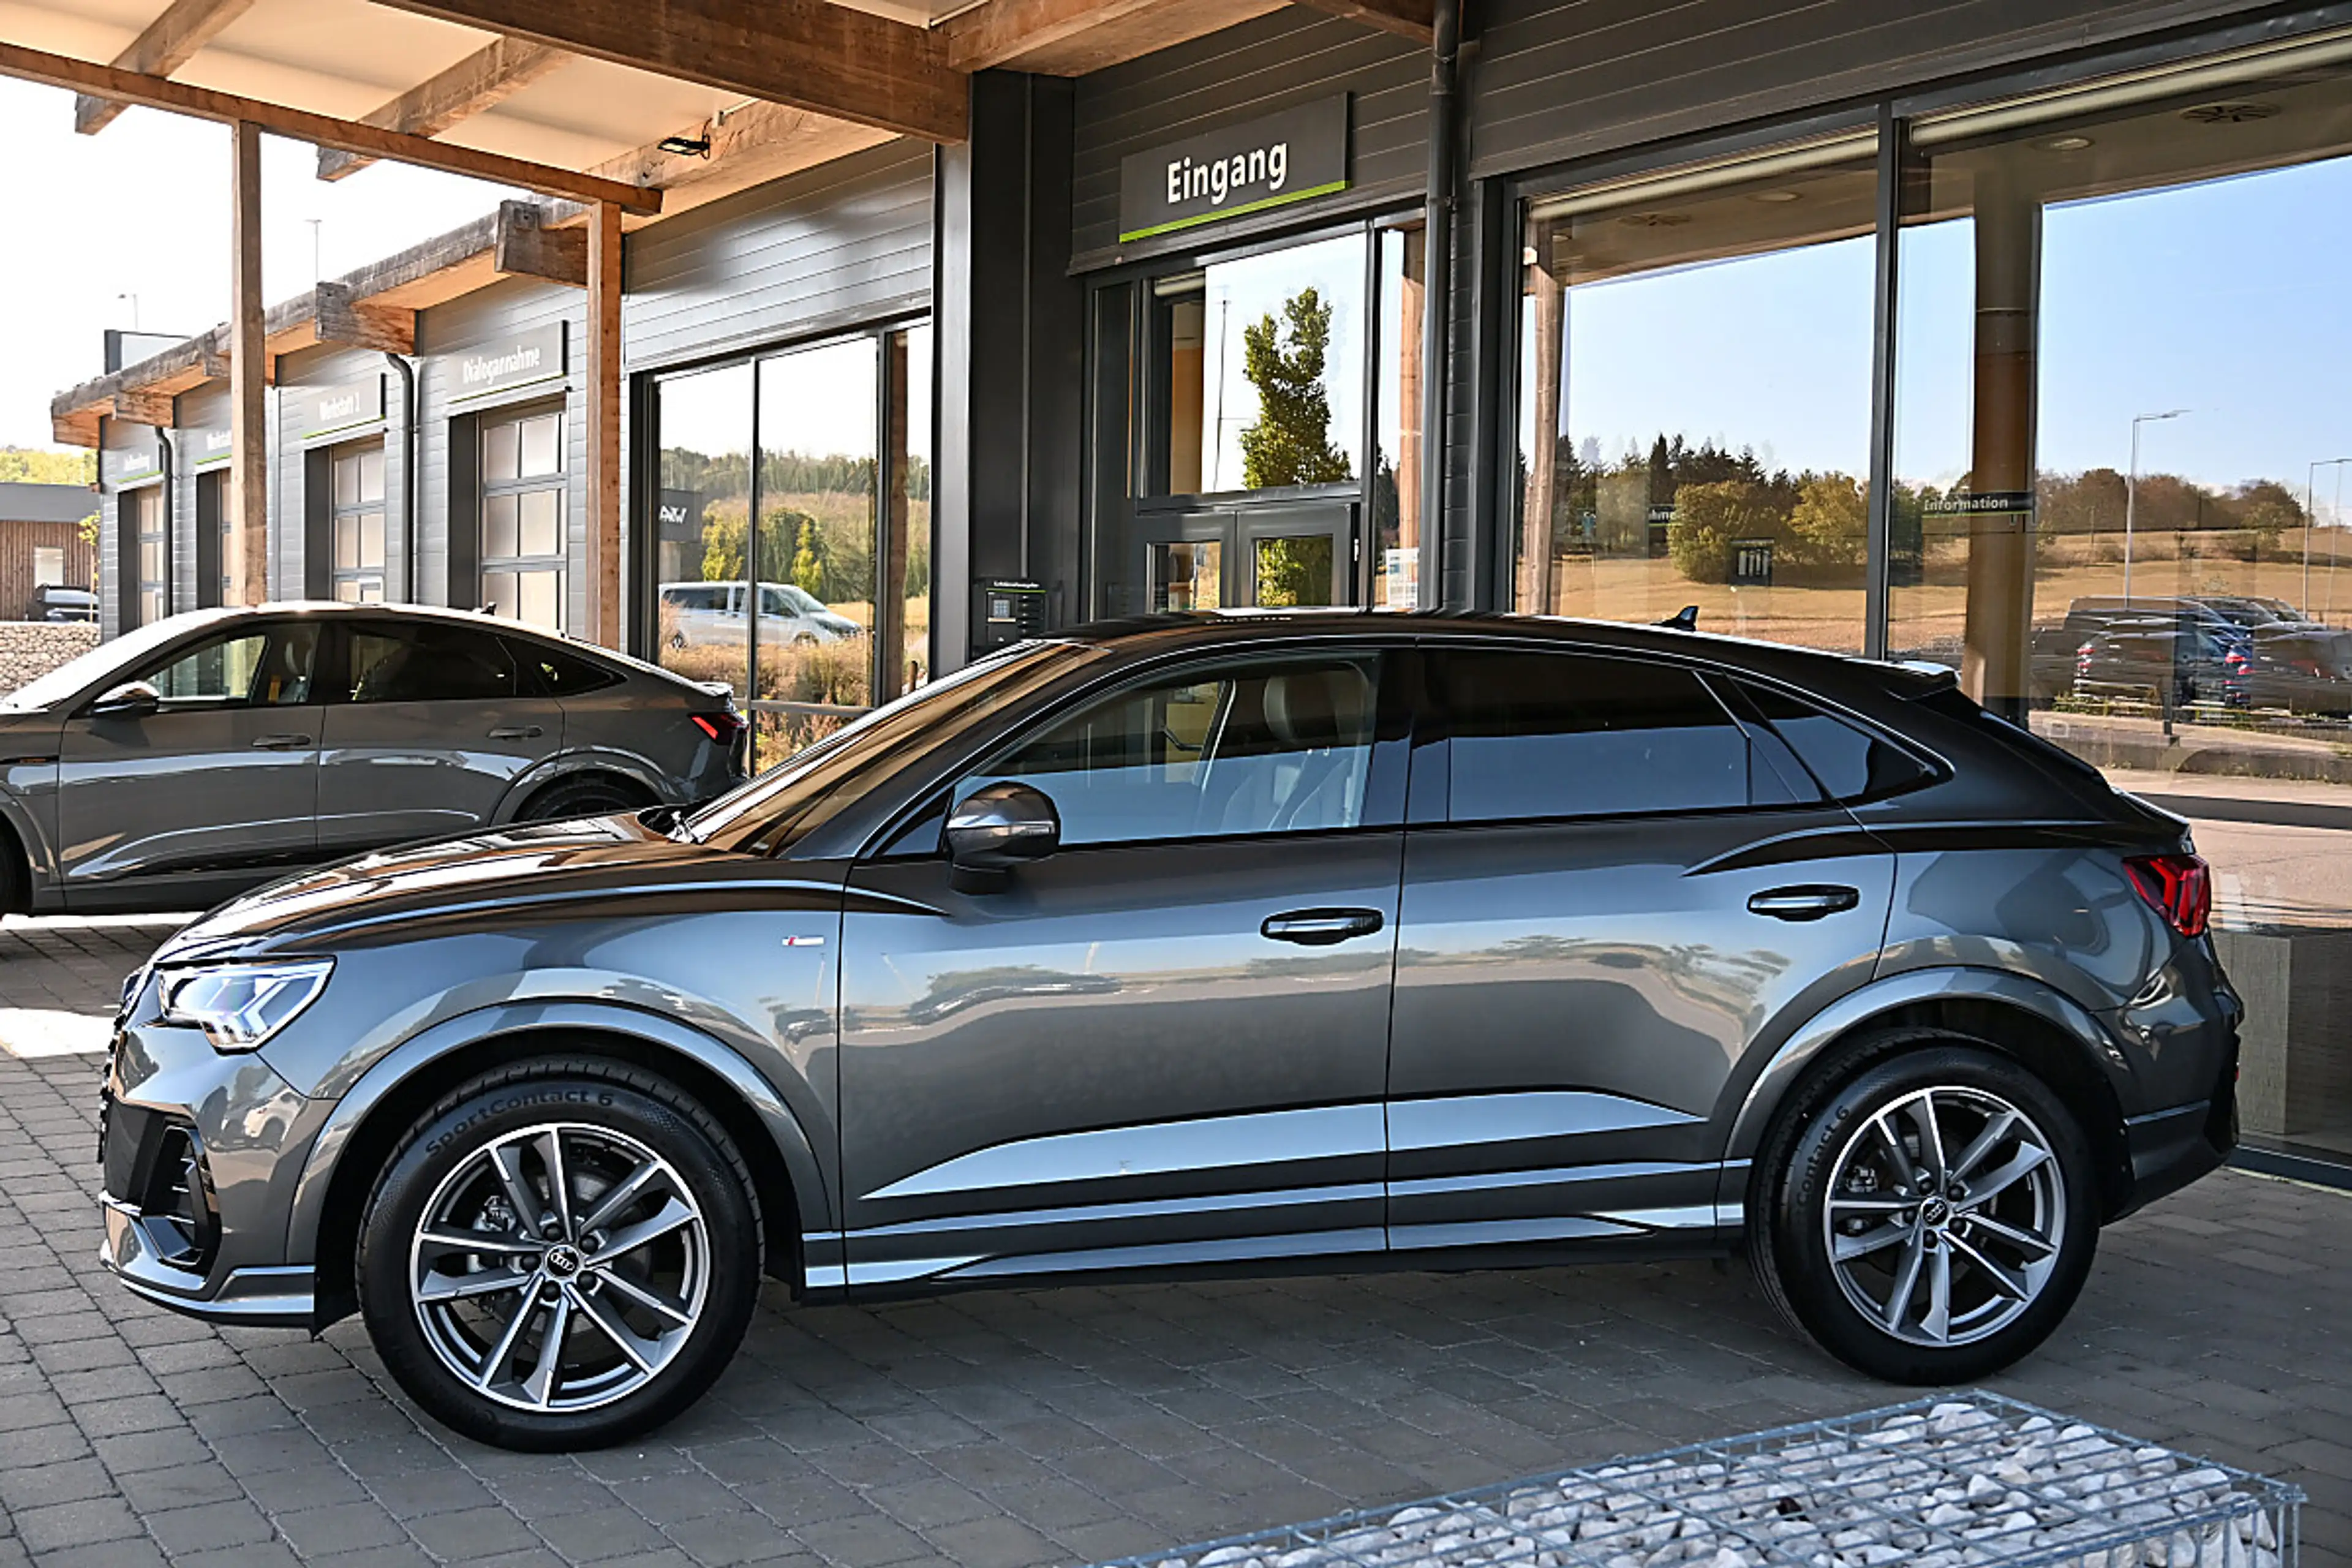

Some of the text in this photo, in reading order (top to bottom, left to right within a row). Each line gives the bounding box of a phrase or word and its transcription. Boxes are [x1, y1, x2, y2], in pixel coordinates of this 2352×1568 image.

[1168, 143, 1287, 205] Eingang
[1924, 496, 2008, 511] Information
[425, 1090, 614, 1158] SportContact 6
[1834, 1105, 1850, 1120] 6
